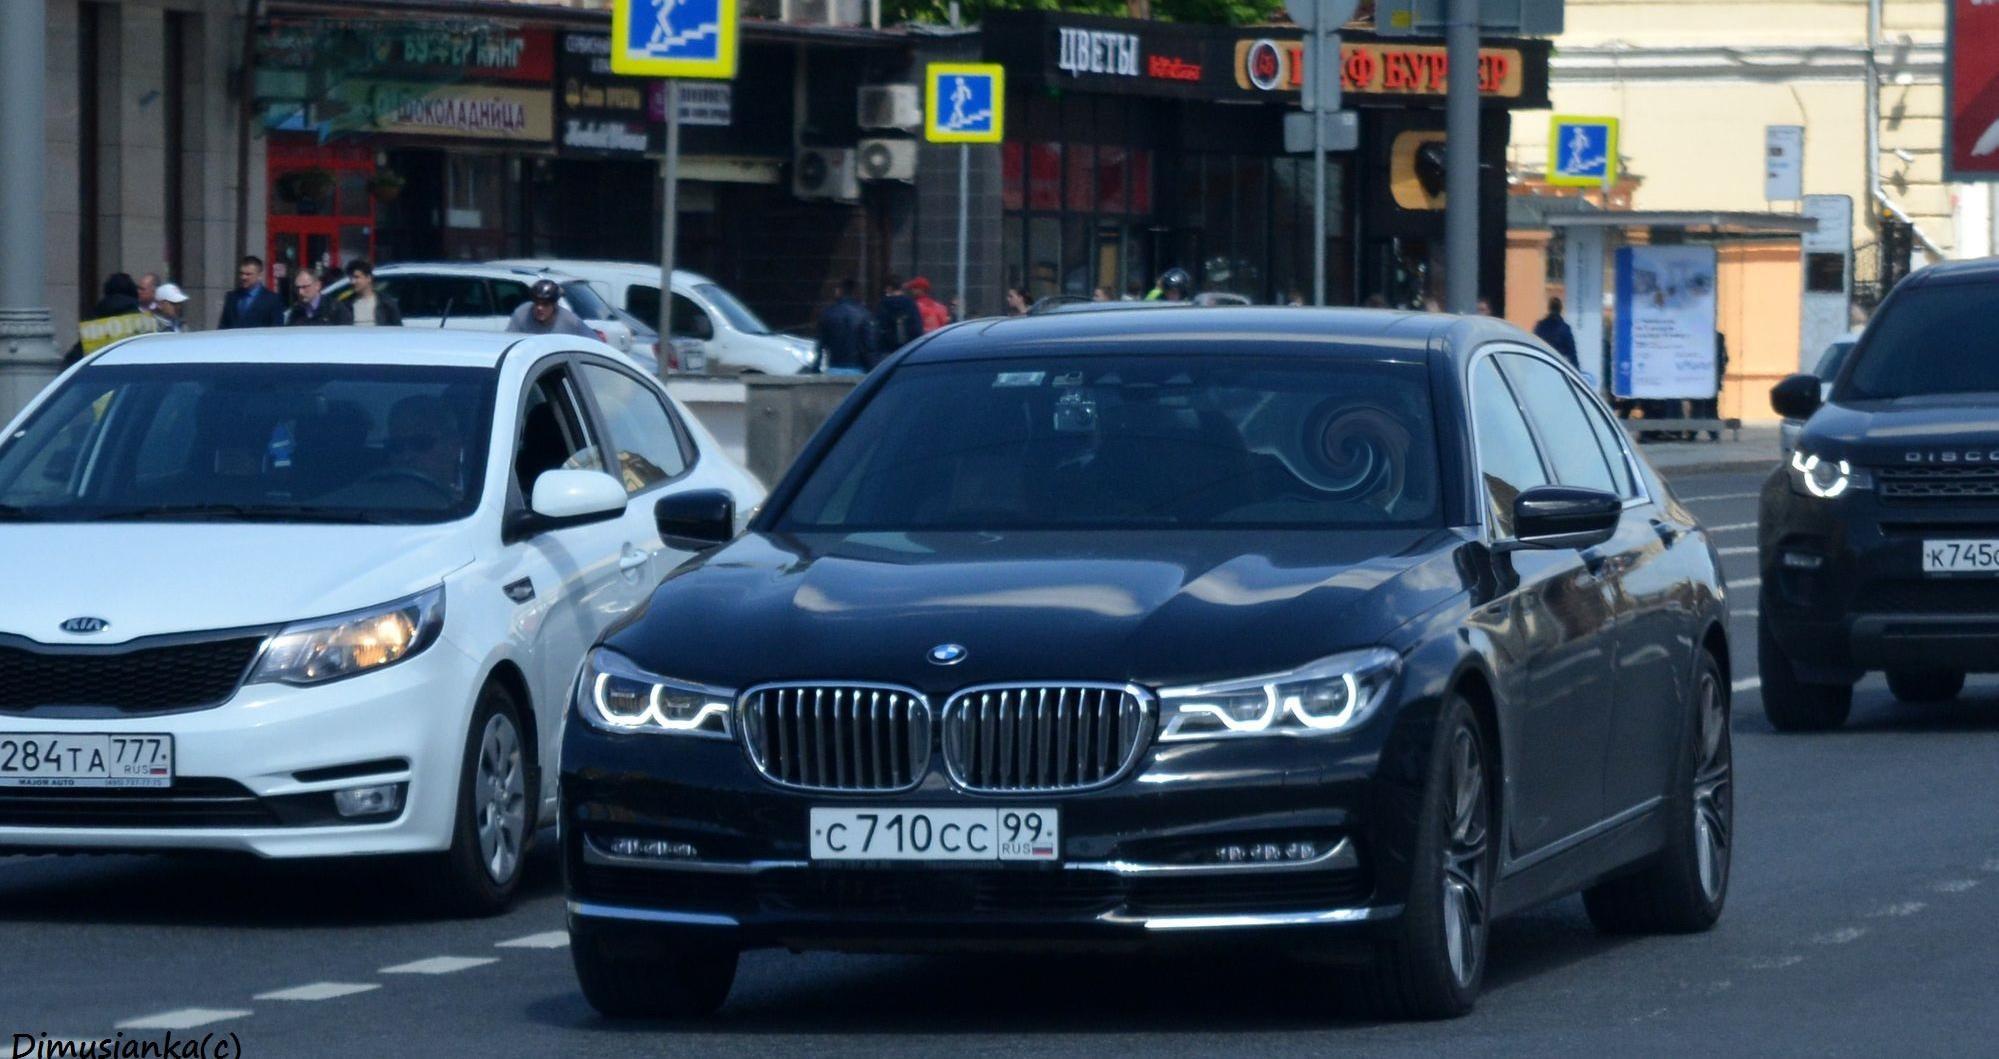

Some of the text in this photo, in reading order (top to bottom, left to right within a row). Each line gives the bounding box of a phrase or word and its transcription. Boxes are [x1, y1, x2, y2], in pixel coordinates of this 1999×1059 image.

[1059, 27, 1140, 78] ЦВЕТЫ
[1383, 50, 1509, 92] БУРЕР
[66, 618, 101, 632] KIA
[112, 738, 161, 764] 777
[124, 764, 149, 775] RUS
[1003, 812, 1043, 842] 99
[1002, 844, 1031, 855] RUS
